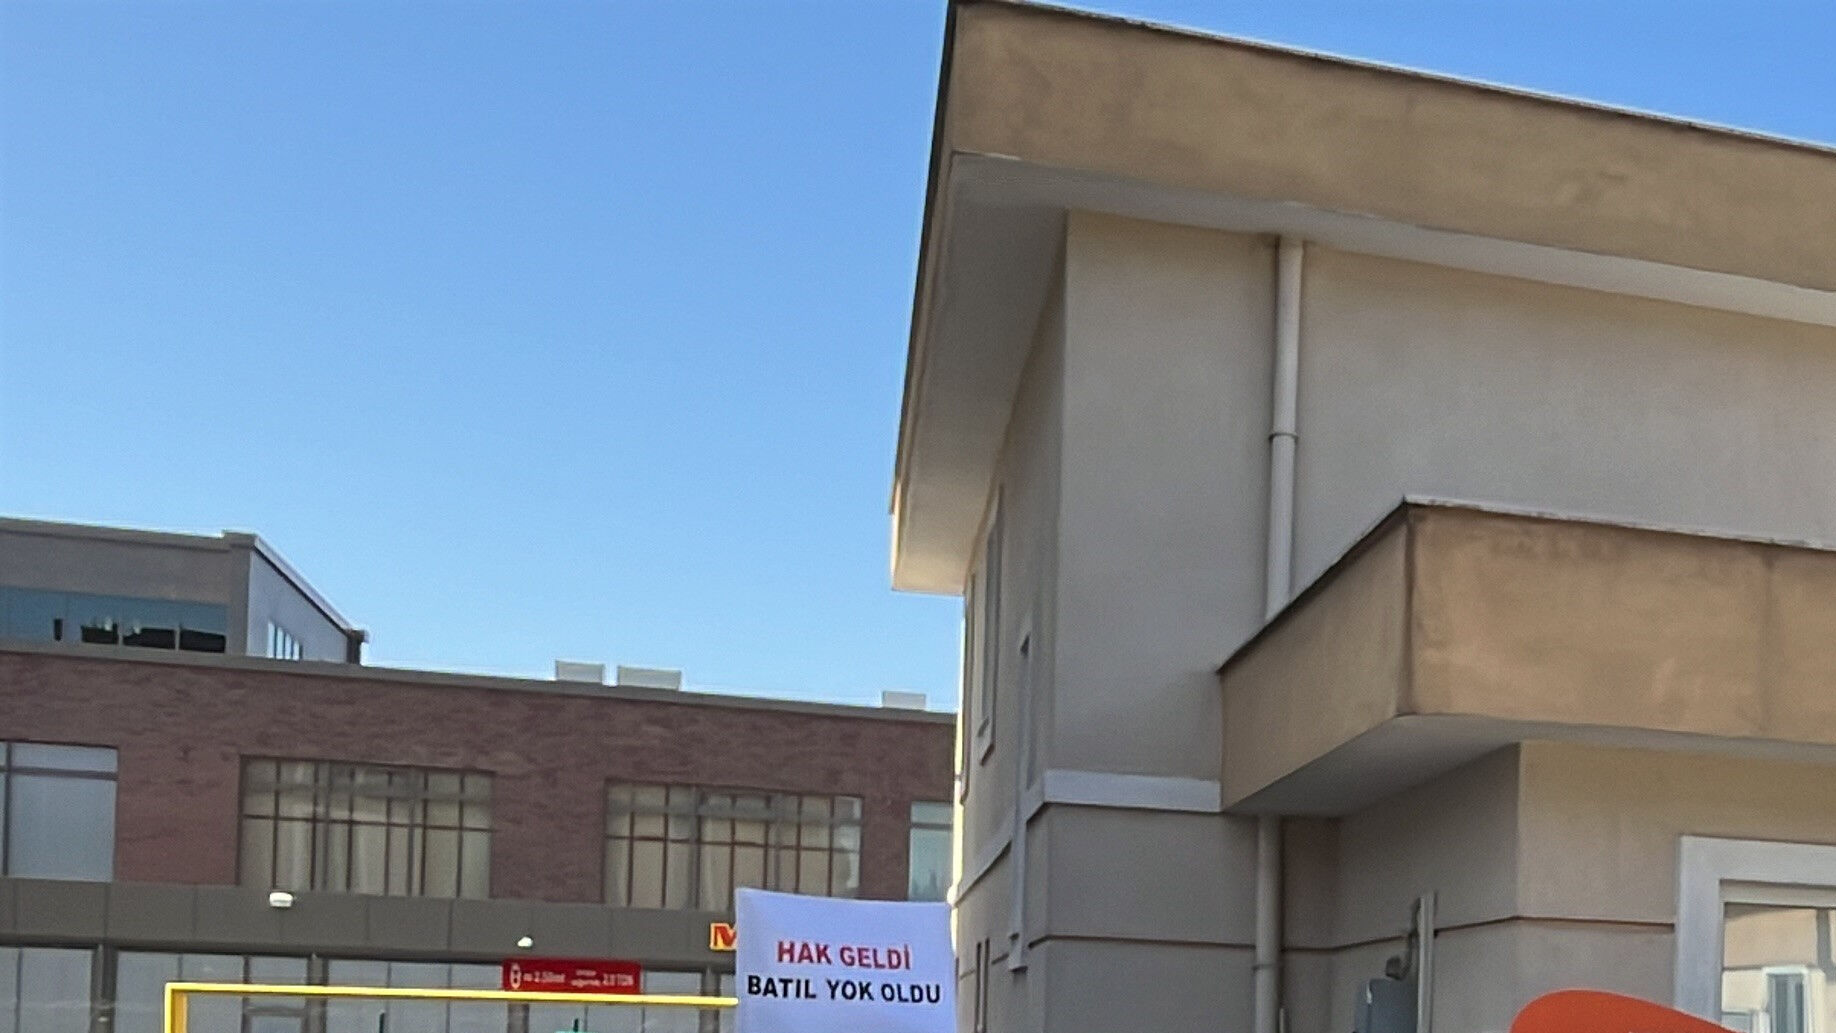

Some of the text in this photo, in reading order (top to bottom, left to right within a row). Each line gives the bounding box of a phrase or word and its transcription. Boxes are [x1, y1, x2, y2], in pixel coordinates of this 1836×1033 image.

[777, 940, 911, 970] HAK GELDİ
[747, 974, 941, 1004] BATIL YOK OLDU
